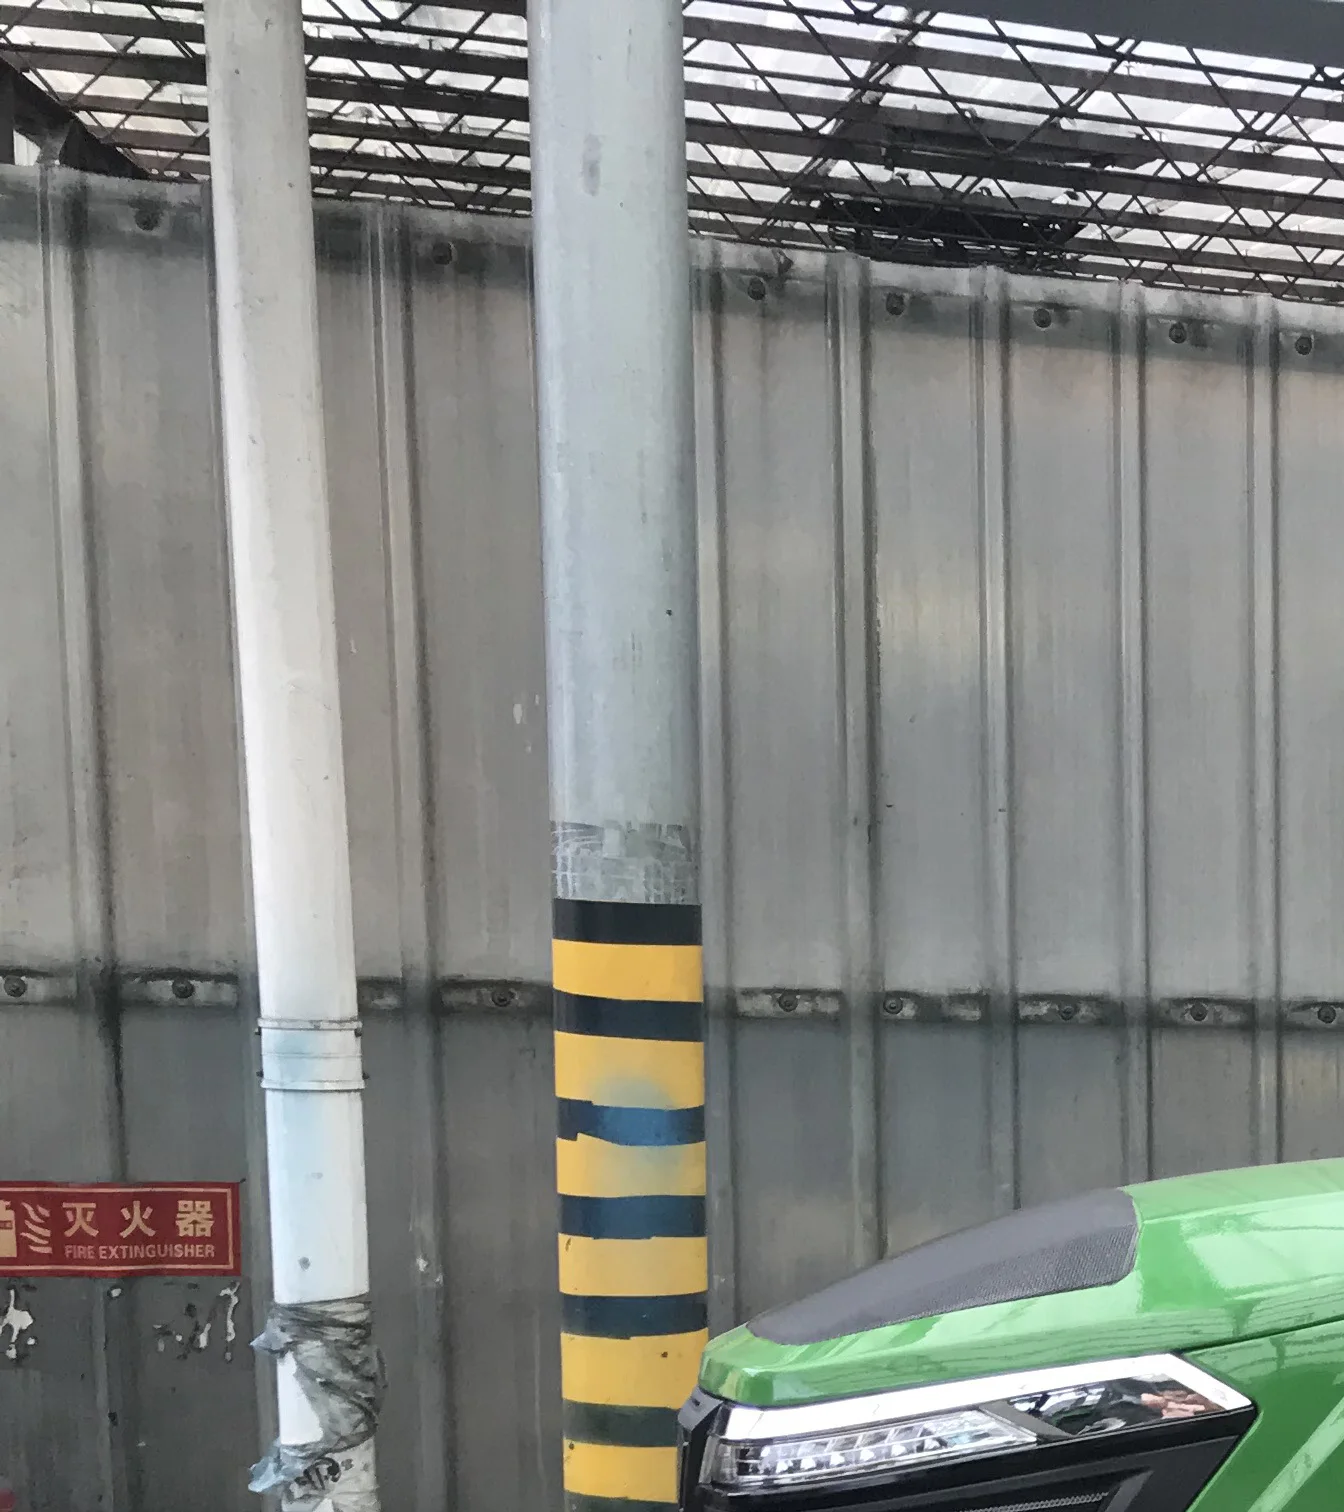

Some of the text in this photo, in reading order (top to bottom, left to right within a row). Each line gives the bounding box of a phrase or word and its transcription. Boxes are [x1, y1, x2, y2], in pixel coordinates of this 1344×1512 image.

[61, 1199, 215, 1239] 灭火器
[64, 1243, 215, 1260] FIRE EXTINGUISHER
